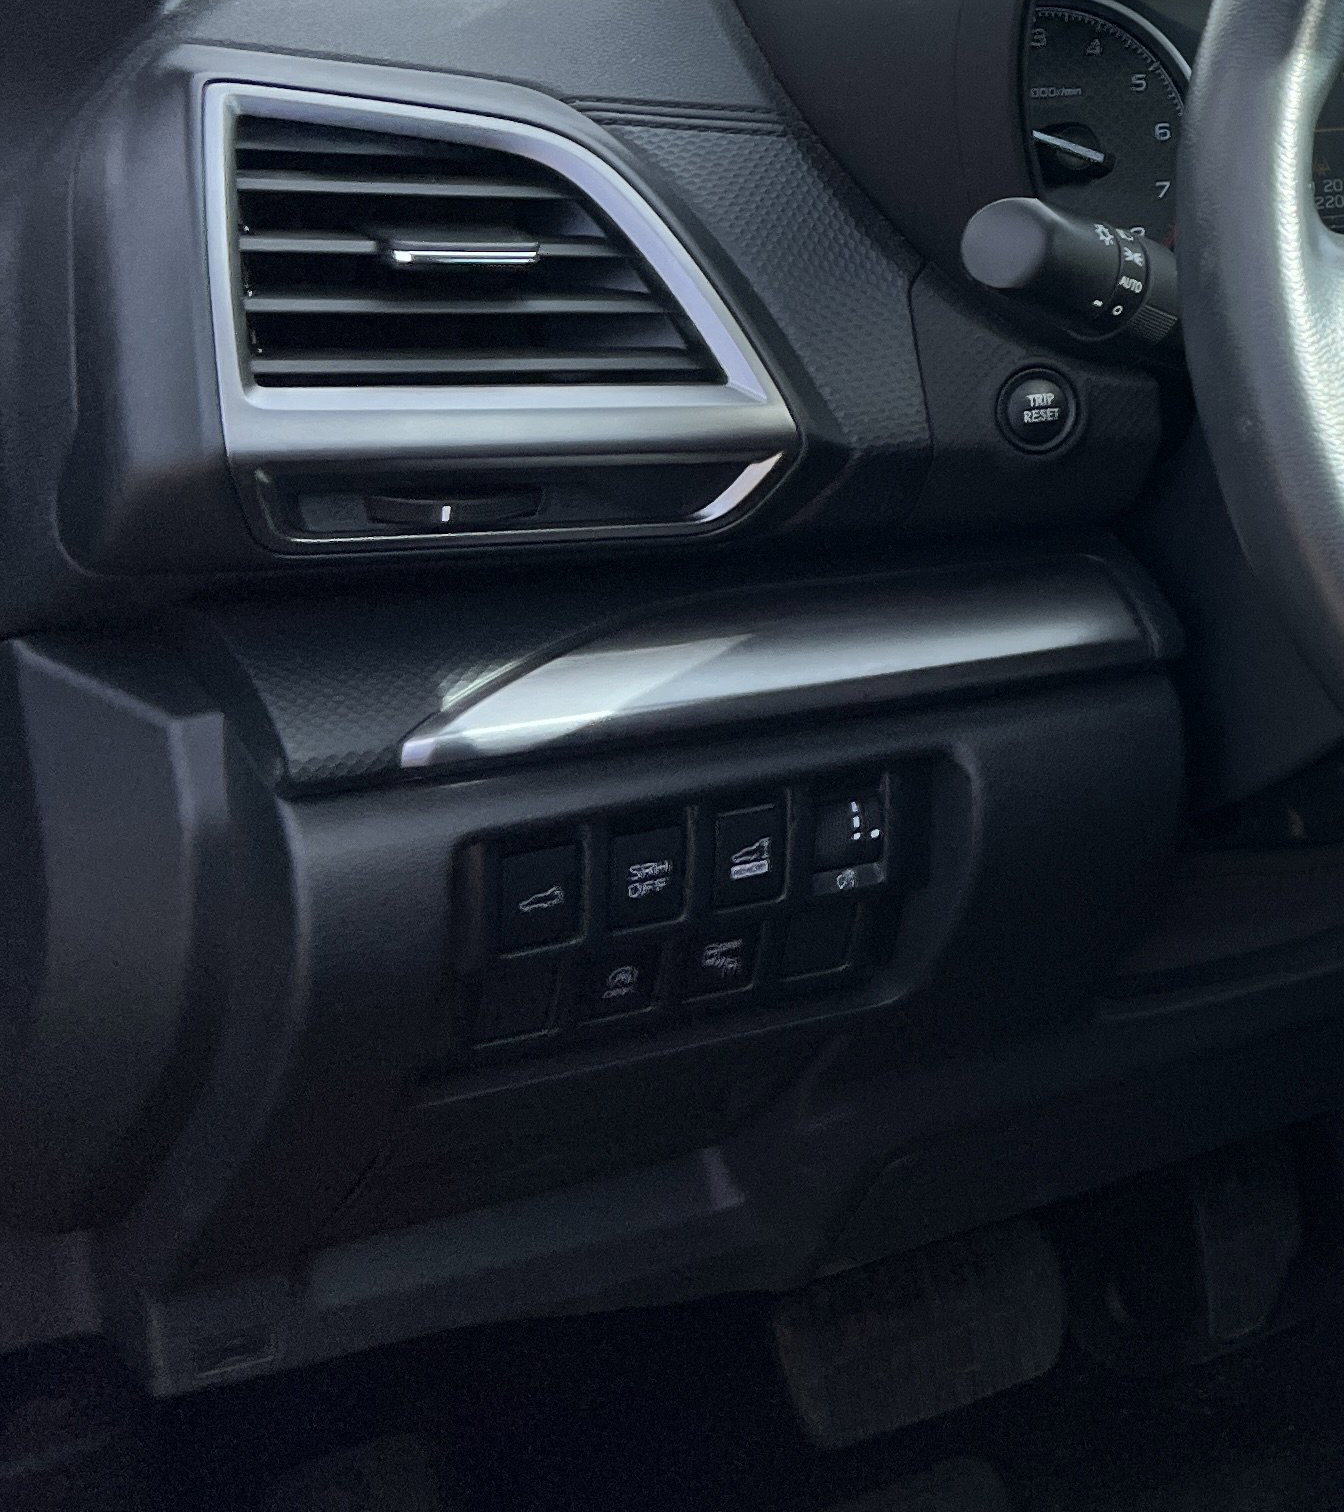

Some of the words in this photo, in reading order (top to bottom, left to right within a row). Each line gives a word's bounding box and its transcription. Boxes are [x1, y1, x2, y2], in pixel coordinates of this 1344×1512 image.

[1130, 73, 1147, 92] 5
[1154, 122, 1172, 141] 6
[1154, 181, 1171, 199] 7
[1119, 275, 1143, 294] AUTO
[1026, 392, 1055, 408] TRIP
[1023, 407, 1060, 424] RESET
